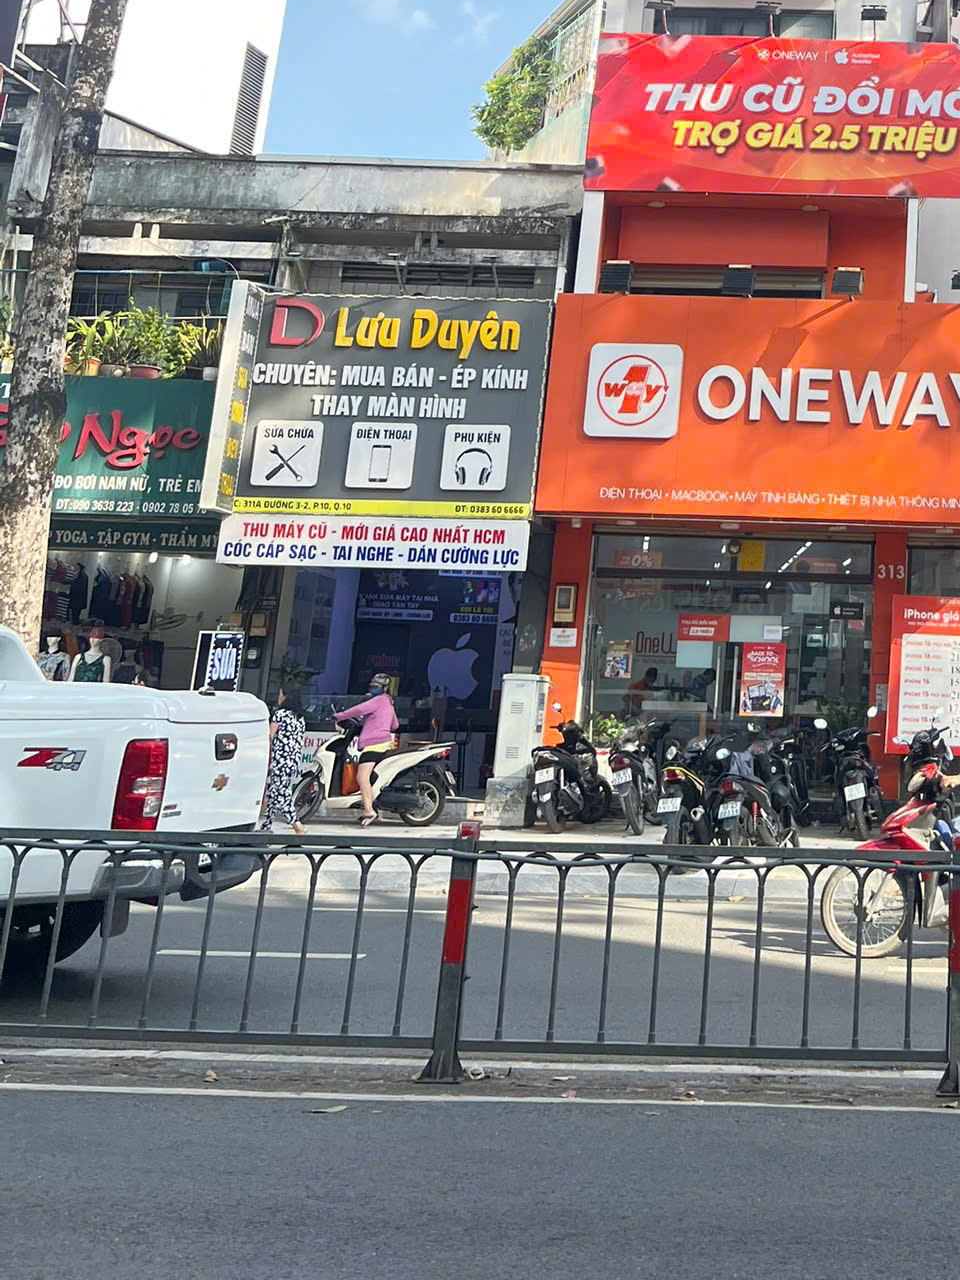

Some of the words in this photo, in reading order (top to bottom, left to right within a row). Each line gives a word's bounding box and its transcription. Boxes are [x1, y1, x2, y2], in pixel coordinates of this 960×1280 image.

[772, 50, 819, 61] ONEWAY
[645, 83, 734, 112] THU
[743, 77, 805, 113] CŨ
[813, 76, 895, 115] ĐỔI
[671, 119, 742, 156] TRỢ
[745, 117, 807, 149] GIÁ
[809, 124, 859, 151] 2.5
[867, 122, 960, 160] TRIỆU
[334, 307, 401, 348] Lưu
[410, 308, 521, 360] Duyên
[252, 360, 337, 386] CHUYÊN:
[341, 365, 386, 388] MUA
[392, 363, 435, 389] BÁN
[451, 363, 477, 390] ÉP
[481, 363, 529, 391] KÍNH
[311, 394, 367, 417] THAY
[367, 392, 416, 418] MÀN
[419, 393, 468, 419] HÌNH
[74, 409, 201, 469] Ngọc
[356, 427, 381, 442] ĐIỆN
[382, 428, 413, 442] THOẠI
[454, 431, 475, 444] PHỤ
[476, 431, 501, 446] KIỆN
[98, 477, 127, 491] NAM
[158, 474, 183, 493] TRẺ
[628, 487, 663, 501] THOẠI
[671, 489, 729, 502] MACBOOK
[92, 500, 115, 512] 3638
[116, 501, 134, 512] 223
[142, 502, 166, 513] 0902
[169, 503, 179, 513] 78
[182, 503, 194, 514] 05
[243, 500, 261, 508] 311A
[470, 505, 490, 513] 0383
[503, 506, 524, 514] 6666
[55, 530, 88, 544] YOGA
[96, 528, 121, 547] TẬP
[122, 531, 151, 545] GYM
[159, 526, 198, 547] THẨM
[243, 522, 269, 537] THU
[273, 520, 304, 539] MÁY
[308, 521, 327, 539] CŨ
[341, 523, 369, 541] MỚI
[372, 524, 396, 541] GIÁ
[400, 526, 428, 542] CAO
[433, 524, 470, 544] NHẤT
[473, 529, 505, 545] HCM
[223, 539, 252, 558] CÓC
[256, 540, 285, 558] CÁP
[289, 544, 317, 562] SẠC
[332, 545, 352, 561] TAI
[356, 546, 394, 562] NGHE
[407, 545, 438, 564] DÁN
[440, 546, 489, 565] CƯỜNG
[493, 549, 519, 568] LỰC
[631, 554, 653, 568] 0%
[877, 564, 905, 579] 313
[904, 608, 940, 620] iPhone
[942, 611, 960, 623] giá
